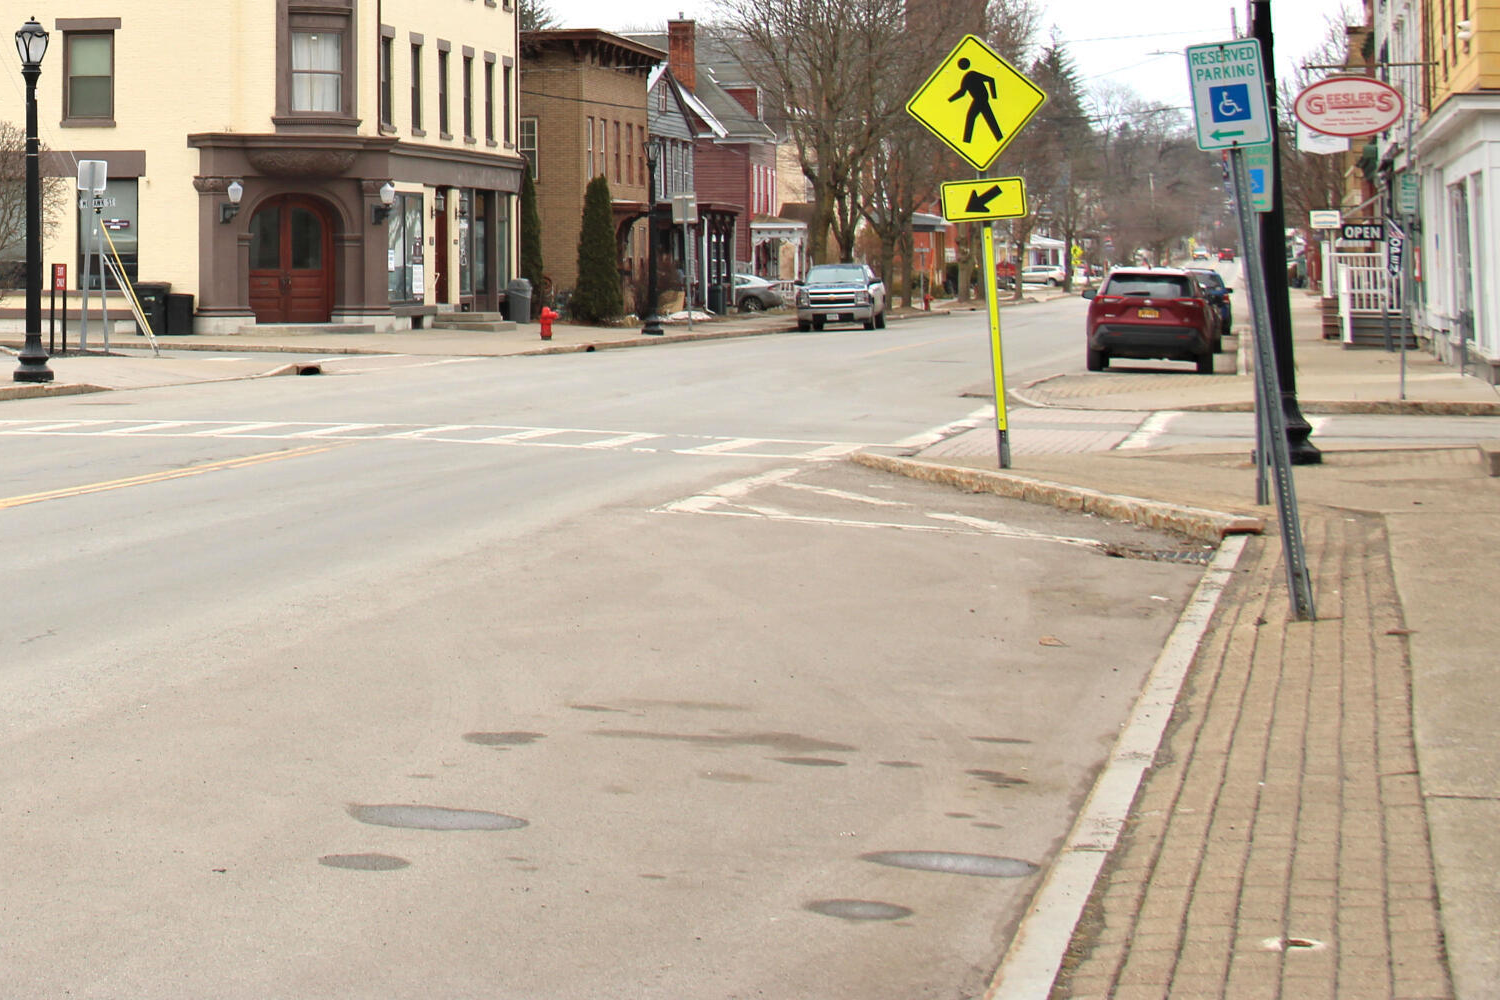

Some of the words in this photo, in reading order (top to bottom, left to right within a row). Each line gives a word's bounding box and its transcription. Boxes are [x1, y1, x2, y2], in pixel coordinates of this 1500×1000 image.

[1191, 47, 1255, 66] RESERVED
[1196, 63, 1256, 82] PARKING
[1344, 226, 1381, 239] OPEN
[1389, 238, 1401, 273] OPEN
